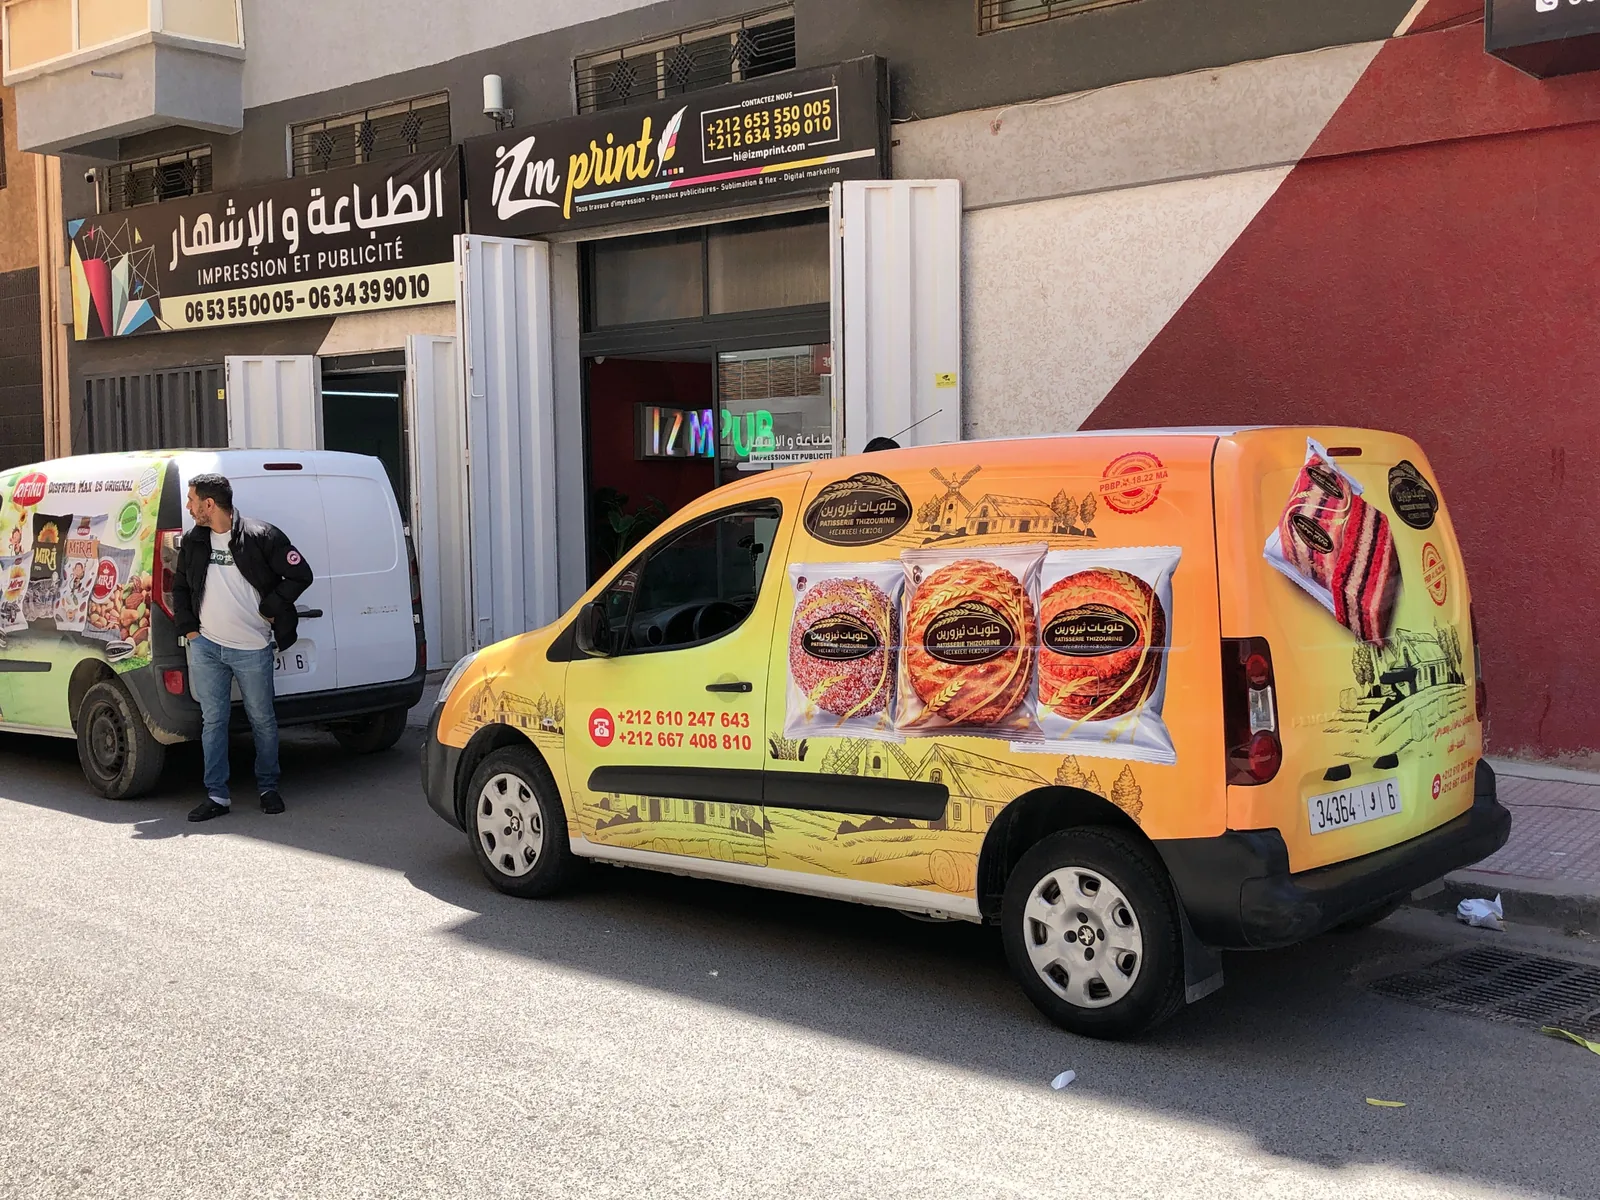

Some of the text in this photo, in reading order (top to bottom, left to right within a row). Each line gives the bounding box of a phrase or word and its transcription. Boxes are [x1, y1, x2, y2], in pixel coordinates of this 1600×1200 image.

[741, 92, 793, 108] CONTACTEZ NOUS
[707, 99, 831, 135] +212 653 550 005
[707, 116, 832, 151] +212 634 399 010
[732, 142, 806, 162] hi@izmprint.com
[563, 116, 654, 219] print
[575, 204, 588, 213] Tous
[588, 201, 609, 211] travaux
[610, 196, 645, 209] d'impression
[651, 191, 679, 201] Panneaux
[720, 180, 757, 191] Sublimation
[758, 178, 764, 186] &
[764, 176, 777, 185] flex
[783, 171, 805, 182] Digital
[806, 166, 840, 177] marketing
[169, 168, 443, 271] الطباعة و الإشهار
[198, 236, 403, 285] IMPRESSION ET PUBLICITÉ
[653, 407, 714, 458] IZM
[859, 500, 897, 514] حلويات
[820, 517, 895, 527] PATISSERIE THIZOURINE
[967, 624, 1000, 637] حلويات
[1087, 623, 1124, 634] حلويات
[966, 639, 1001, 648] THIZOURINE
[296, 654, 304, 670] 6
[618, 709, 750, 728] +212 610 247 643
[619, 730, 752, 750] +212 667 408 810
[1317, 793, 1356, 828] 34364
[1386, 783, 1396, 810] 6
